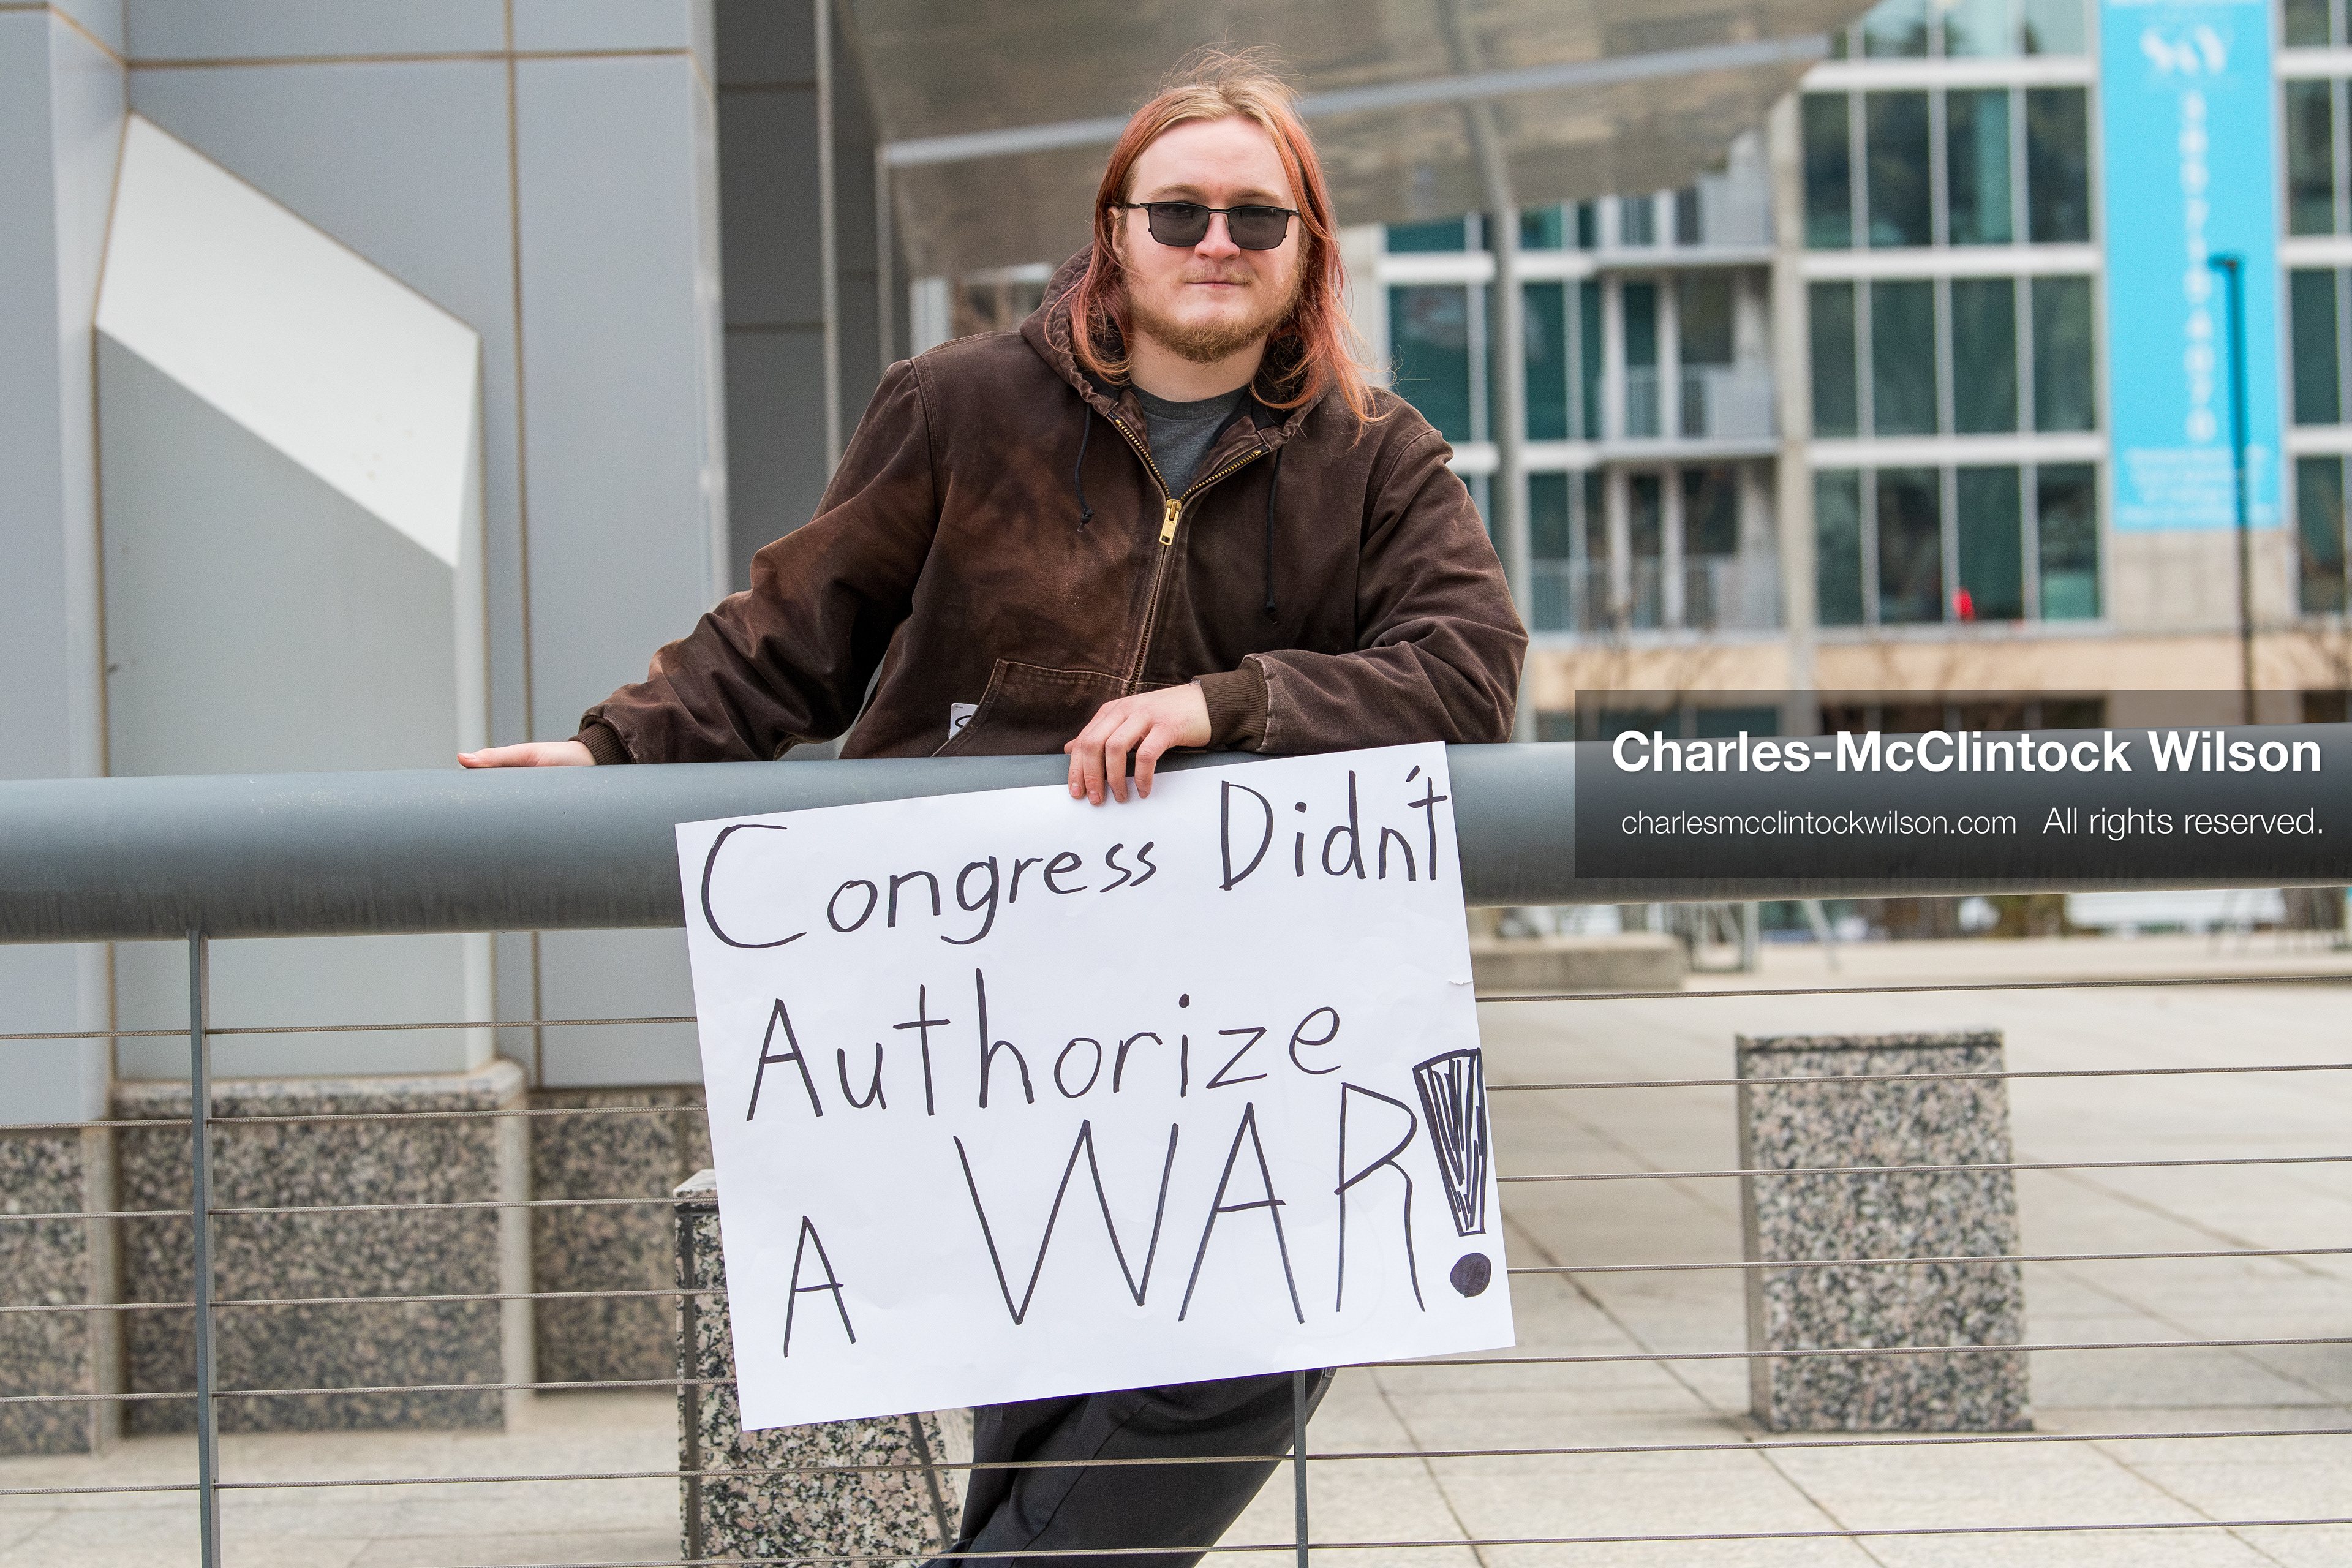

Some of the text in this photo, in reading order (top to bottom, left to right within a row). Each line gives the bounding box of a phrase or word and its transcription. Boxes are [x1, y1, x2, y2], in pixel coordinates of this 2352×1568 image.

[701, 764, 1448, 949] Congress Didn't
[746, 967, 1341, 1121] Authorize
[783, 1047, 1492, 1359] A WAR!
